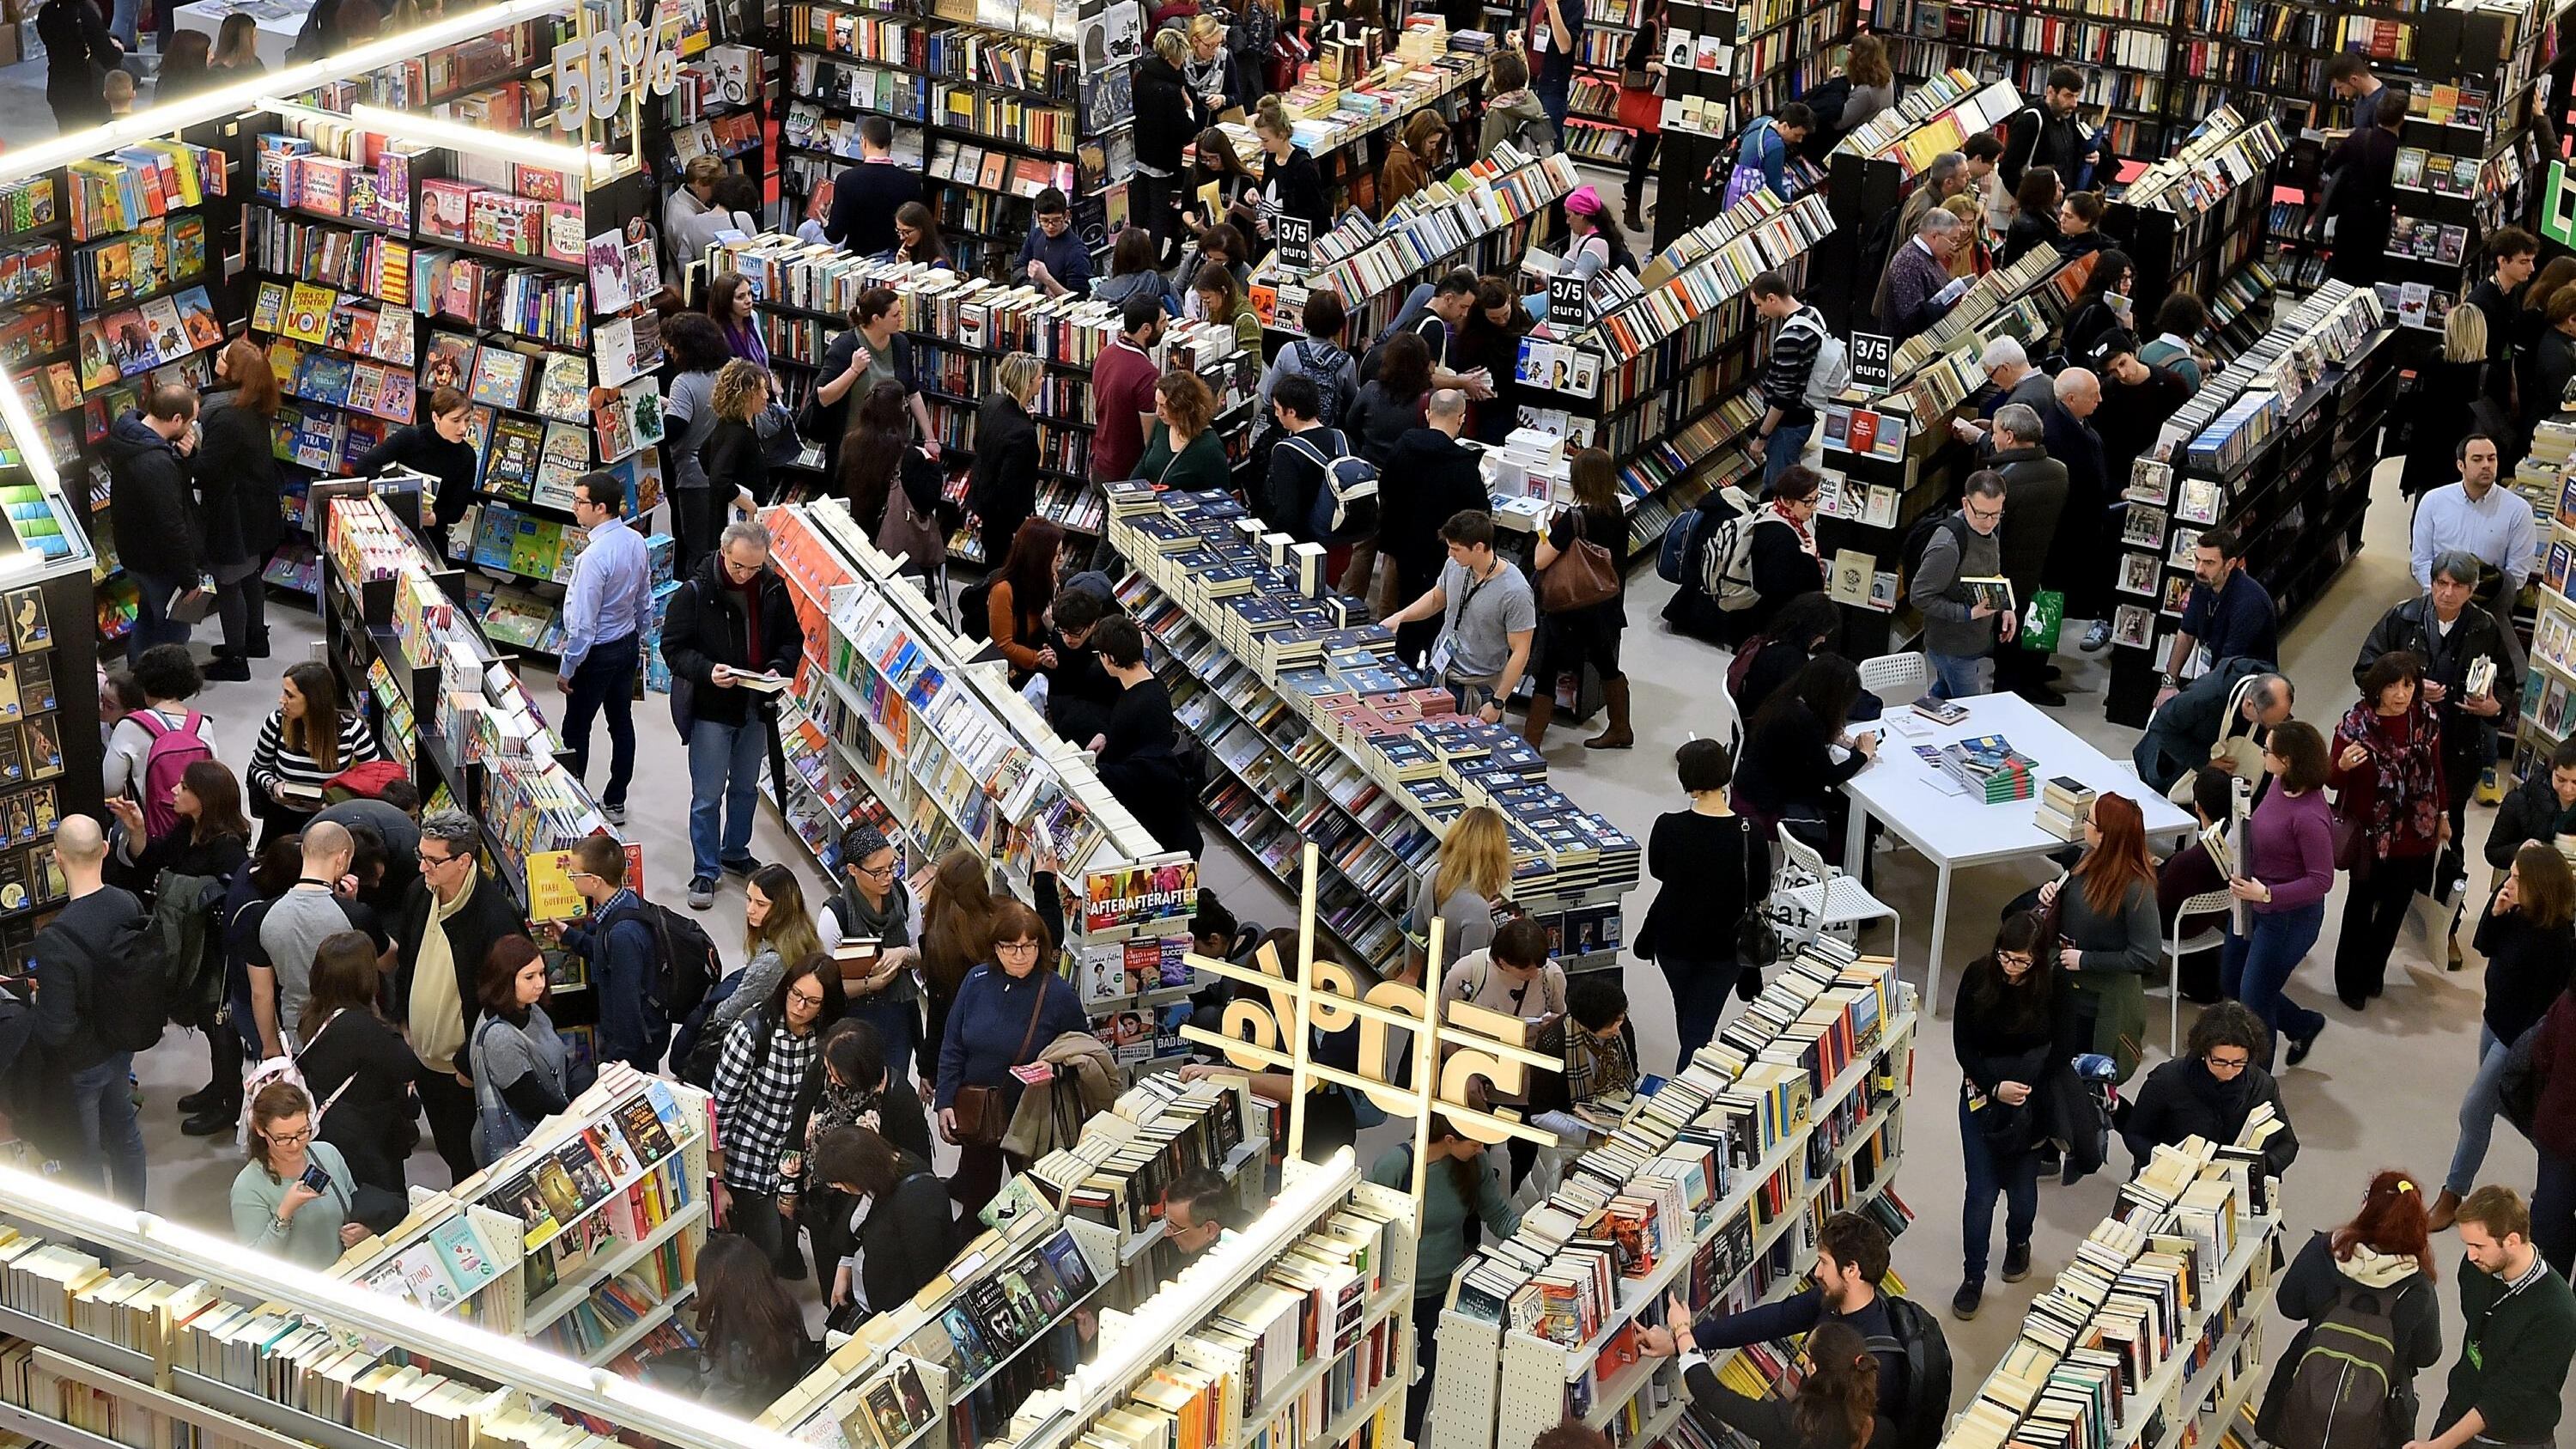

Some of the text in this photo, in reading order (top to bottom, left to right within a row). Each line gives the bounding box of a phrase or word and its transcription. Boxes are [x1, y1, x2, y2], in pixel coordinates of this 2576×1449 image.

[551, 3, 677, 131] 50%
[788, 112, 814, 126] CALCIO
[1281, 222, 1307, 242] 3/5
[1281, 247, 1307, 259] euro
[262, 291, 280, 301] QUIZ
[295, 291, 312, 301] COSA
[1552, 282, 1582, 301] 3/5
[297, 298, 327, 307] DENTRO
[1552, 305, 1582, 318] euro
[608, 327, 631, 344] EATALY
[1856, 339, 1886, 361] 3/5
[1856, 364, 1886, 378] euro
[304, 434, 319, 446] TRA
[508, 435, 526, 448] CERCA
[506, 449, 523, 460] TROVA
[500, 459, 524, 474] CONTA
[546, 453, 586, 471] WILDLIFE
[541, 883, 559, 892] FIABE
[544, 895, 577, 907] GUERRIERI
[1126, 892, 1162, 910] AFTER
[1161, 887, 1198, 907] AFTER
[1090, 898, 1126, 916] AFTER
[1157, 1035, 1176, 1049] BAD
[633, 1111, 648, 1123] COLPA
[410, 1263, 434, 1287] JUNO
[1577, 1281, 1586, 1299] KING
[1466, 1297, 1493, 1313] RAGAZZA
[1476, 1297, 1485, 1306] LA
[1473, 1306, 1491, 1318] FUGA
[1523, 1295, 1544, 1324] KING
